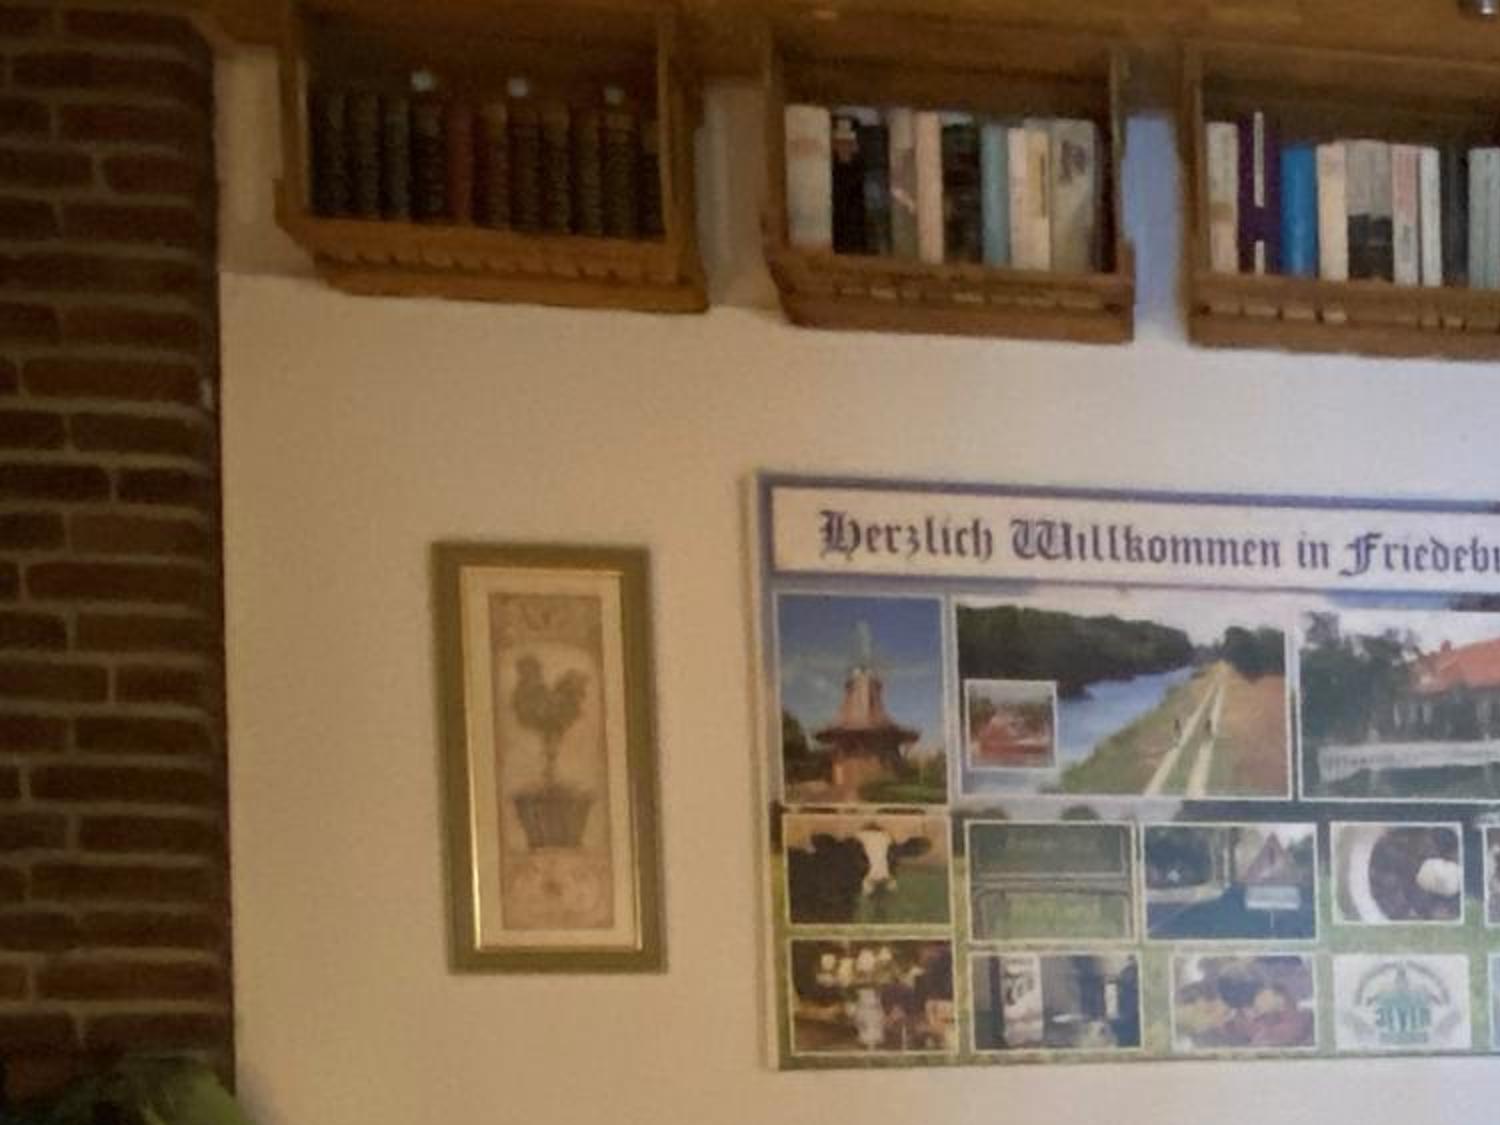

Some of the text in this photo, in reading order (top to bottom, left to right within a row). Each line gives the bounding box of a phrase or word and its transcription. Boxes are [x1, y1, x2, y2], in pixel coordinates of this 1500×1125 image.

[819, 509, 994, 560] Herzlich
[1010, 519, 1280, 569] Willkommen
[1299, 530, 1329, 570] in
